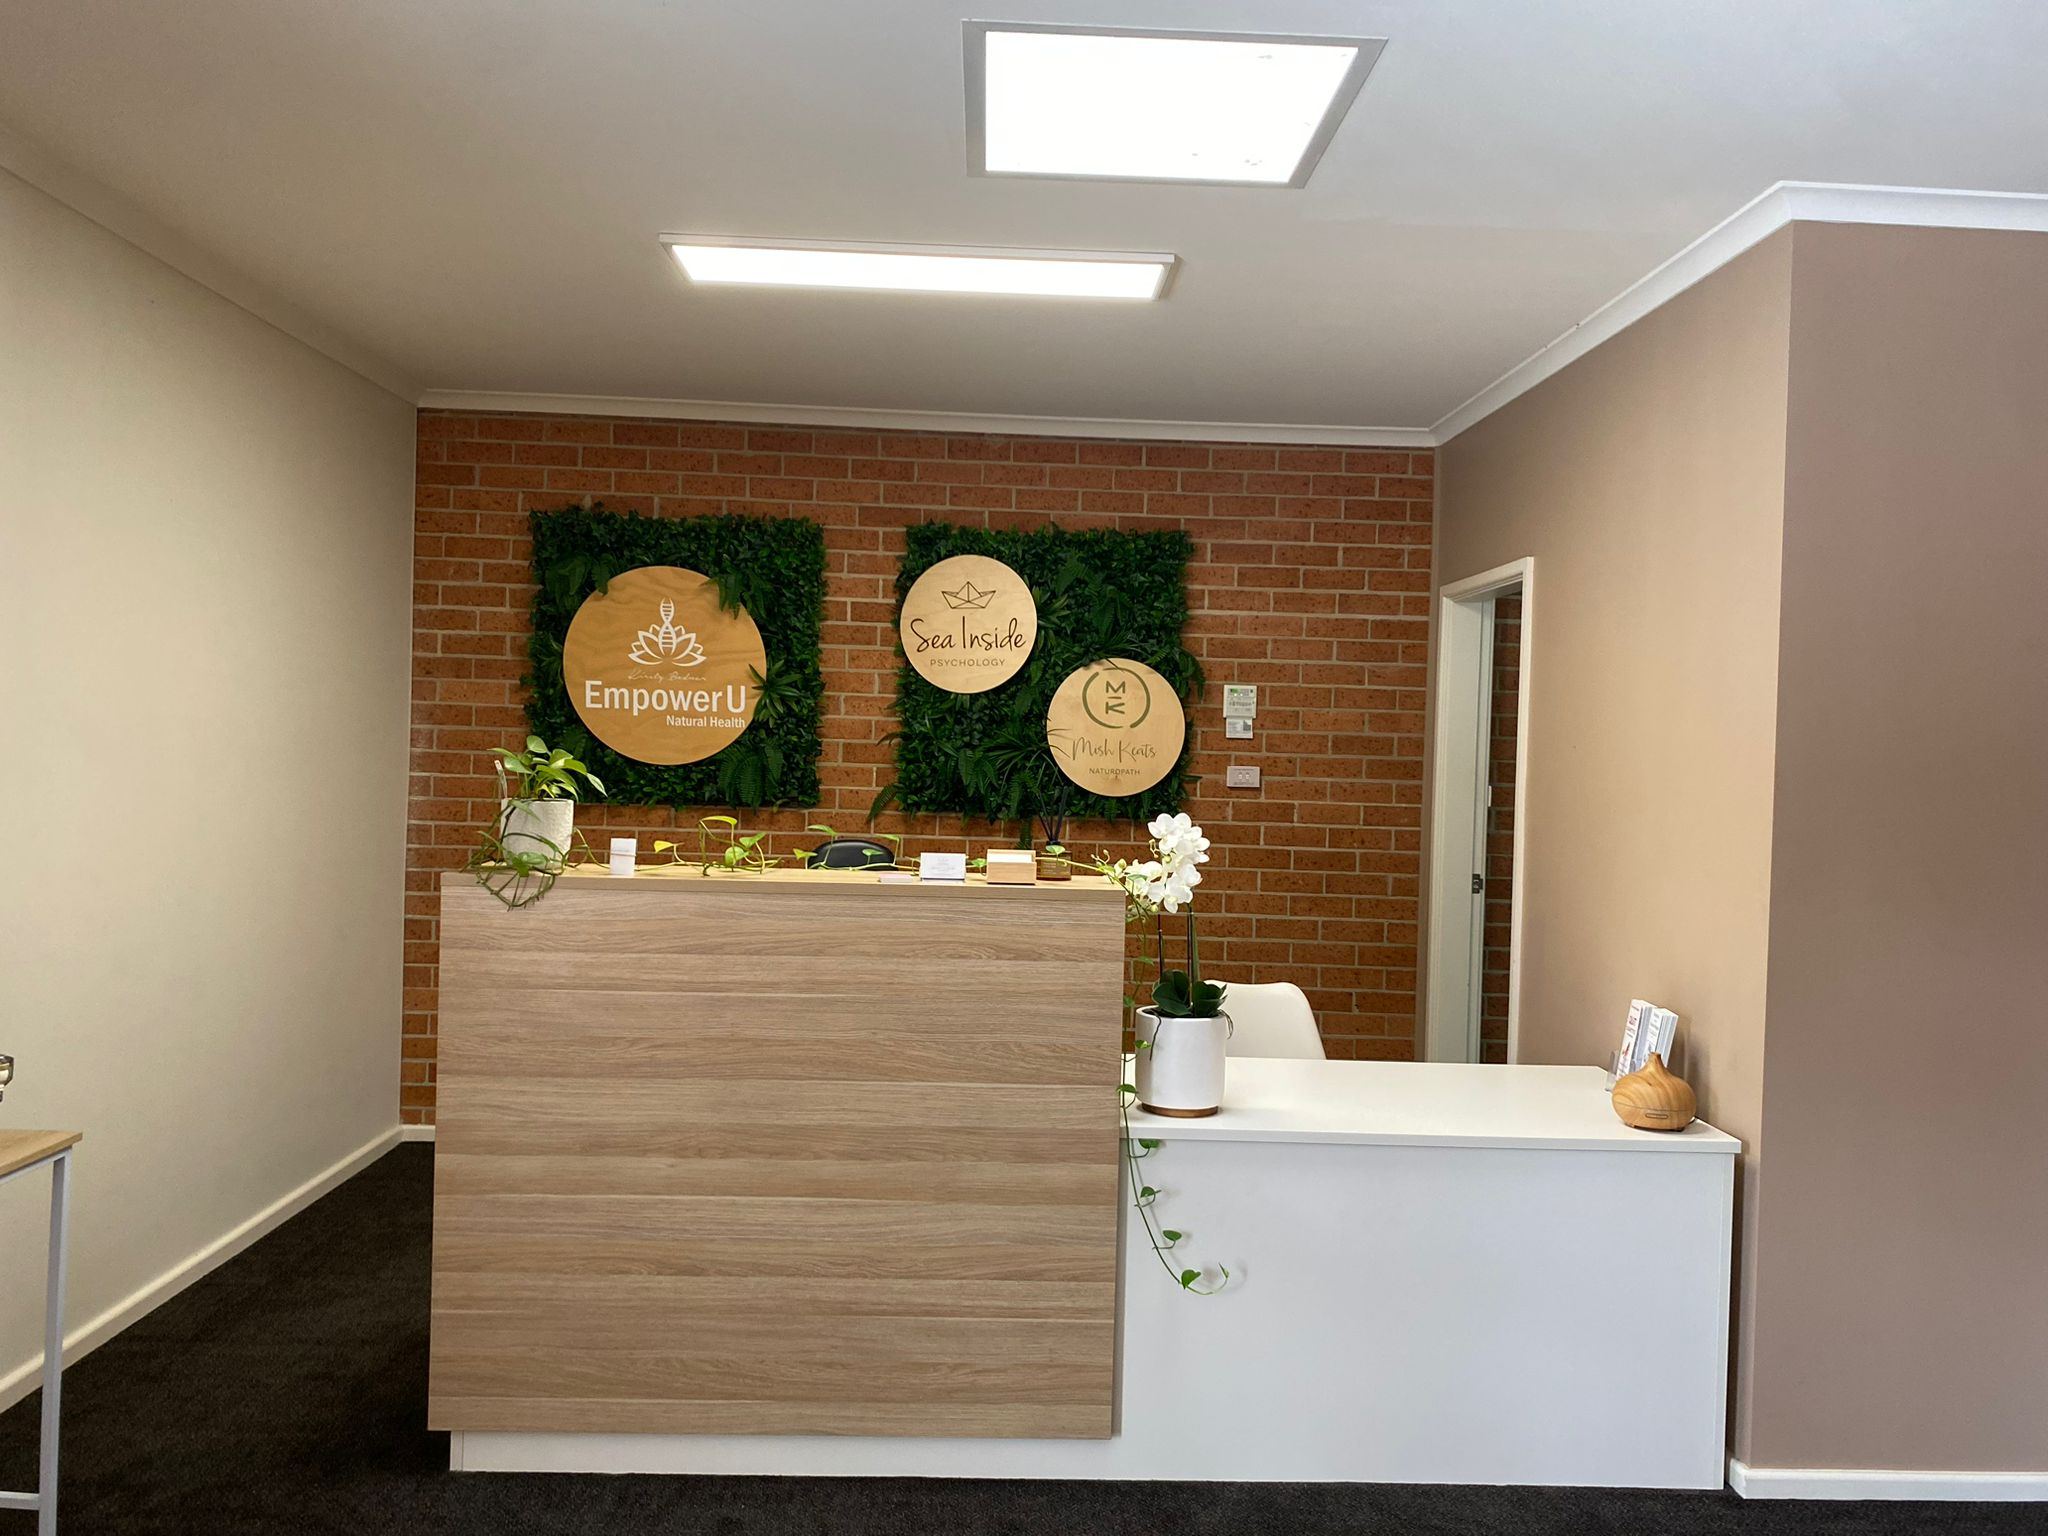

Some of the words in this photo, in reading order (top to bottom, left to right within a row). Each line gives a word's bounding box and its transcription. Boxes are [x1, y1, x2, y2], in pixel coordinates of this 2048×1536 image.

[910, 618, 956, 653] Sea
[962, 615, 1027, 652] Inside
[930, 658, 1006, 668] PSYCHOLOGY
[1105, 680, 1126, 694] M
[1105, 701, 1126, 715] K
[666, 715, 708, 728] Natural
[709, 716, 746, 729] Health
[1118, 740, 1158, 763] Keats
[1088, 767, 1141, 776] NATUROPATH
